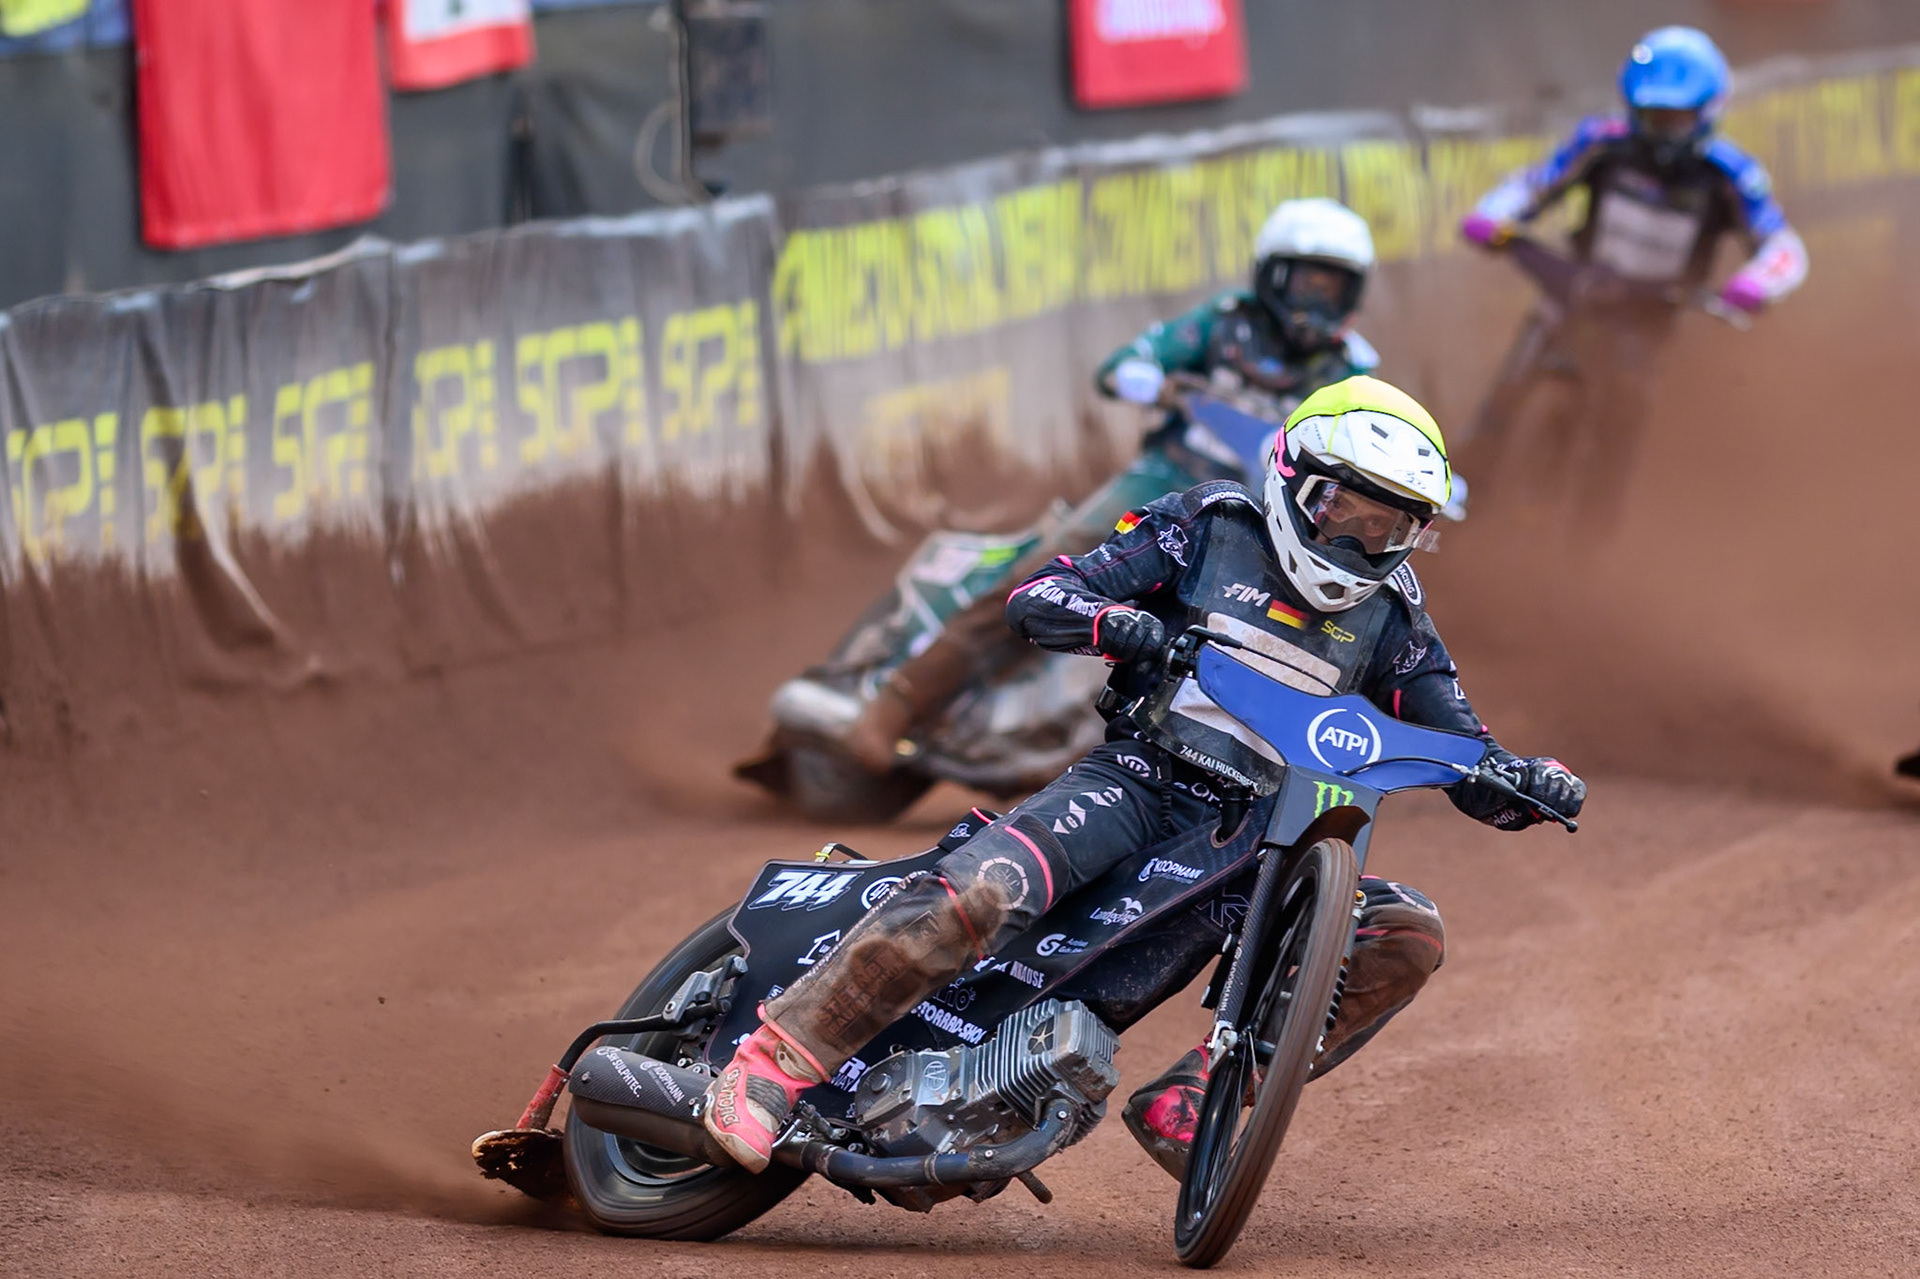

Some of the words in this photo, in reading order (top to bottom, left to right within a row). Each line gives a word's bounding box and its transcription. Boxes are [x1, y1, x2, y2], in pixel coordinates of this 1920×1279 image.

[1222, 582, 1271, 607] FIM
[1321, 620, 1356, 643] SGP
[1318, 726, 1369, 756] ATPI
[1179, 744, 1198, 762] 744
[1197, 754, 1215, 769] KAI
[750, 870, 862, 909] 744
[1010, 960, 1046, 989] KRAUSE
[654, 1066, 685, 1103] KOOPMANN
